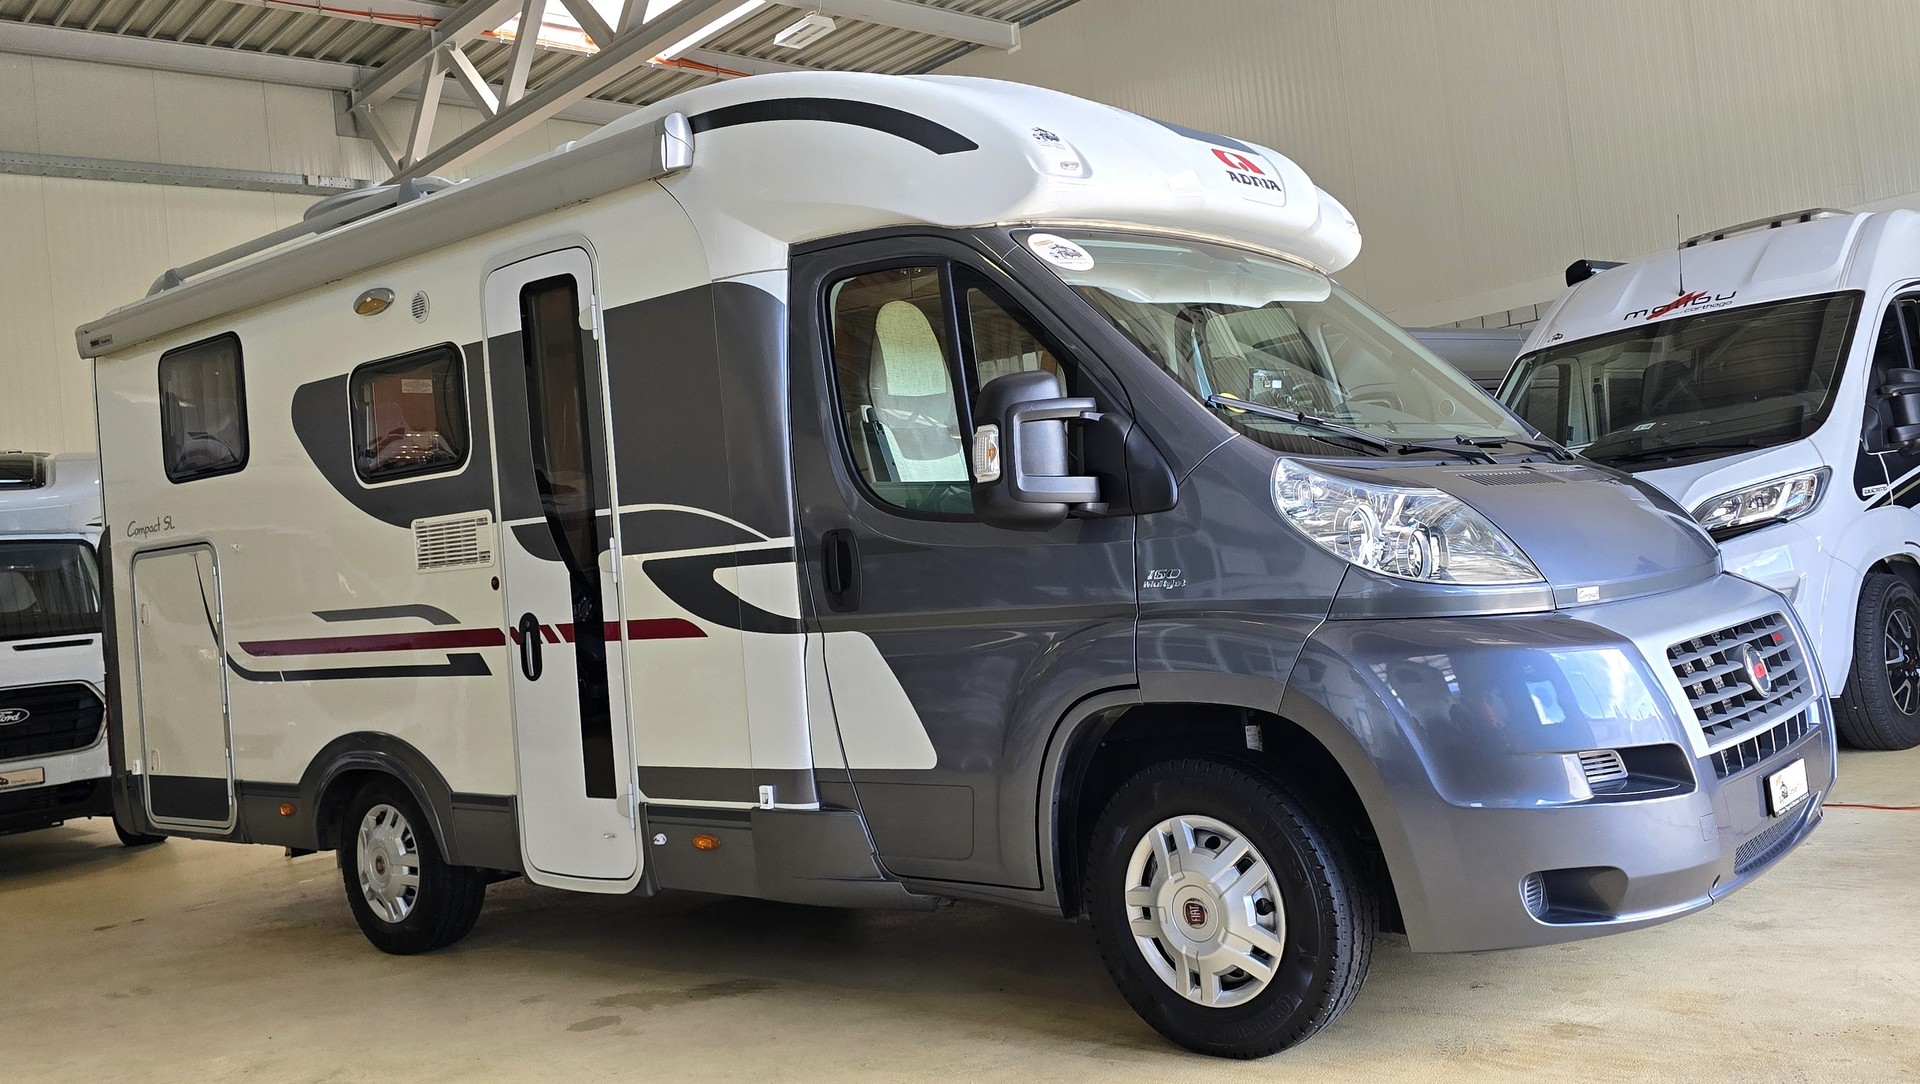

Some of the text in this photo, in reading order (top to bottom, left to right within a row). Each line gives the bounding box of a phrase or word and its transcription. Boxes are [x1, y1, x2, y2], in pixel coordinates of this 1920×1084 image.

[1226, 170, 1281, 192] ADRIA
[1624, 291, 1737, 320] malibu
[127, 515, 175, 538] Compact SL
[1147, 569, 1181, 580] 160
[1189, 904, 1201, 923] FIAT
